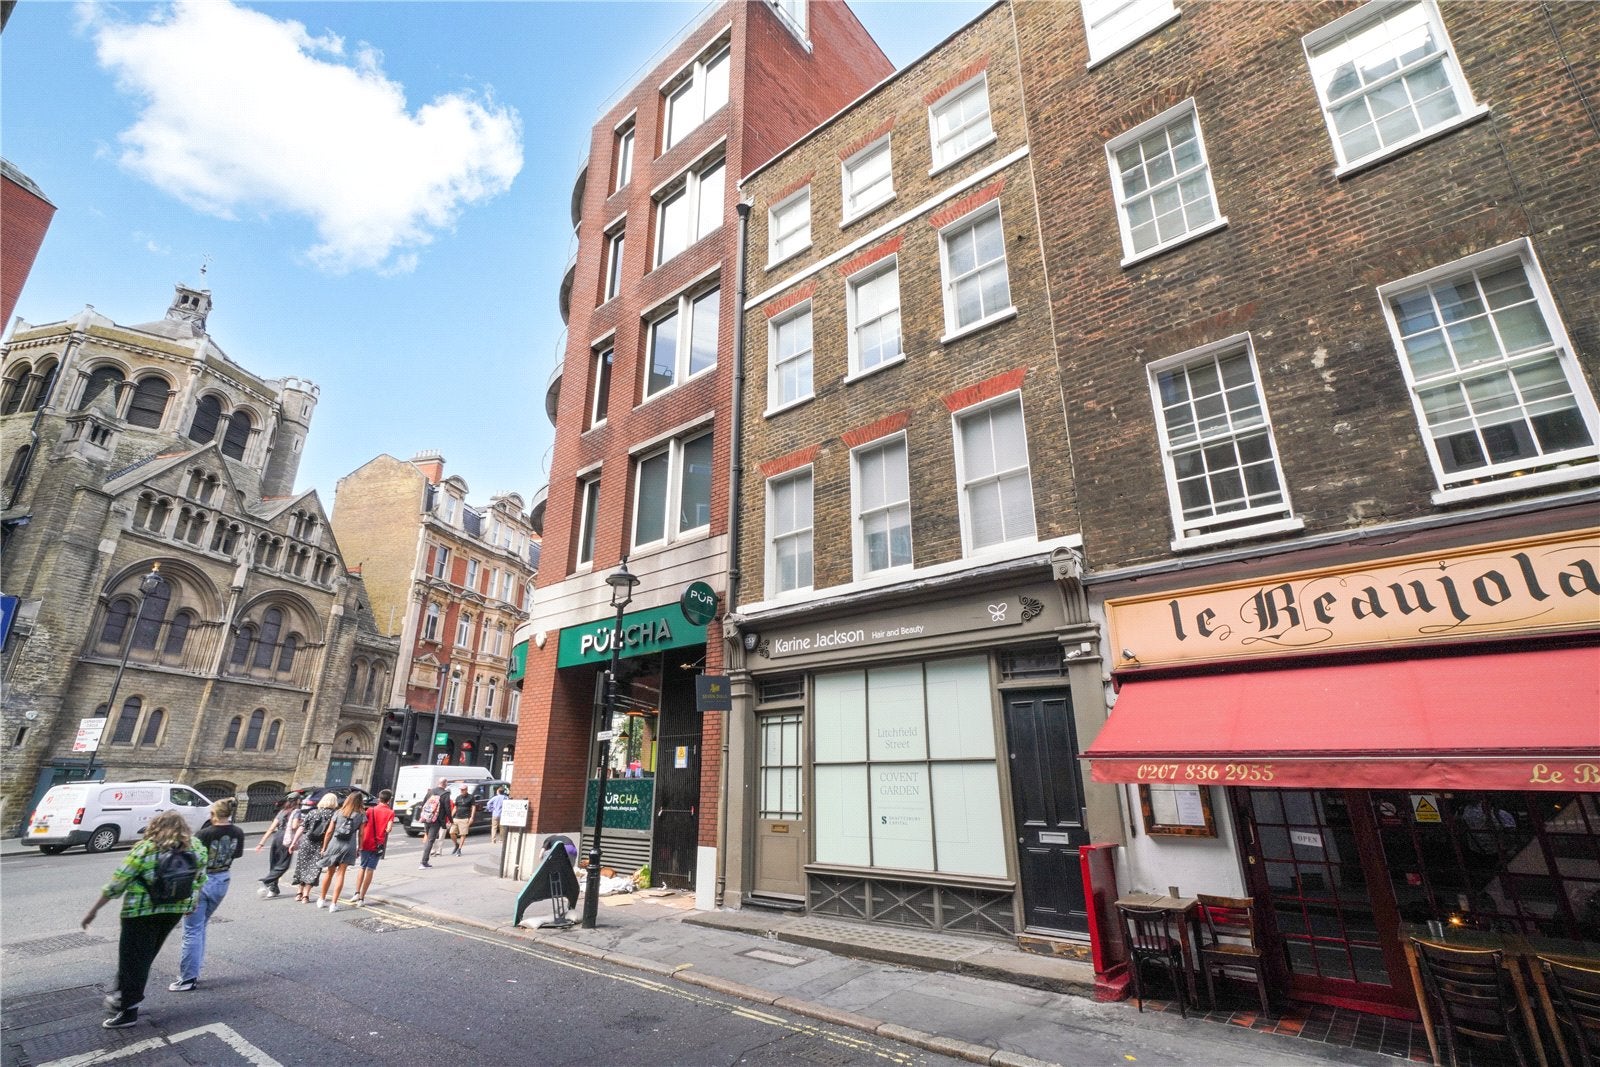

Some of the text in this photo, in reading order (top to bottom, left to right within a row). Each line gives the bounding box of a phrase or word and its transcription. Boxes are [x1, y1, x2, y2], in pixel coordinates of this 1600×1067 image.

[690, 590, 714, 606] PÜR
[1169, 600, 1231, 642] le
[775, 624, 925, 653] Karine Jackson Hair and Beauty
[877, 727, 918, 738] Litchfield
[884, 740, 911, 749] Street
[880, 772, 919, 781] COVENT
[1137, 764, 1275, 781] 0207 836 2955
[1529, 763, 1566, 783] Le
[880, 785, 920, 796] GARDEN
[605, 792, 639, 805] ÜRCHA
[1297, 835, 1318, 843] OPEN
